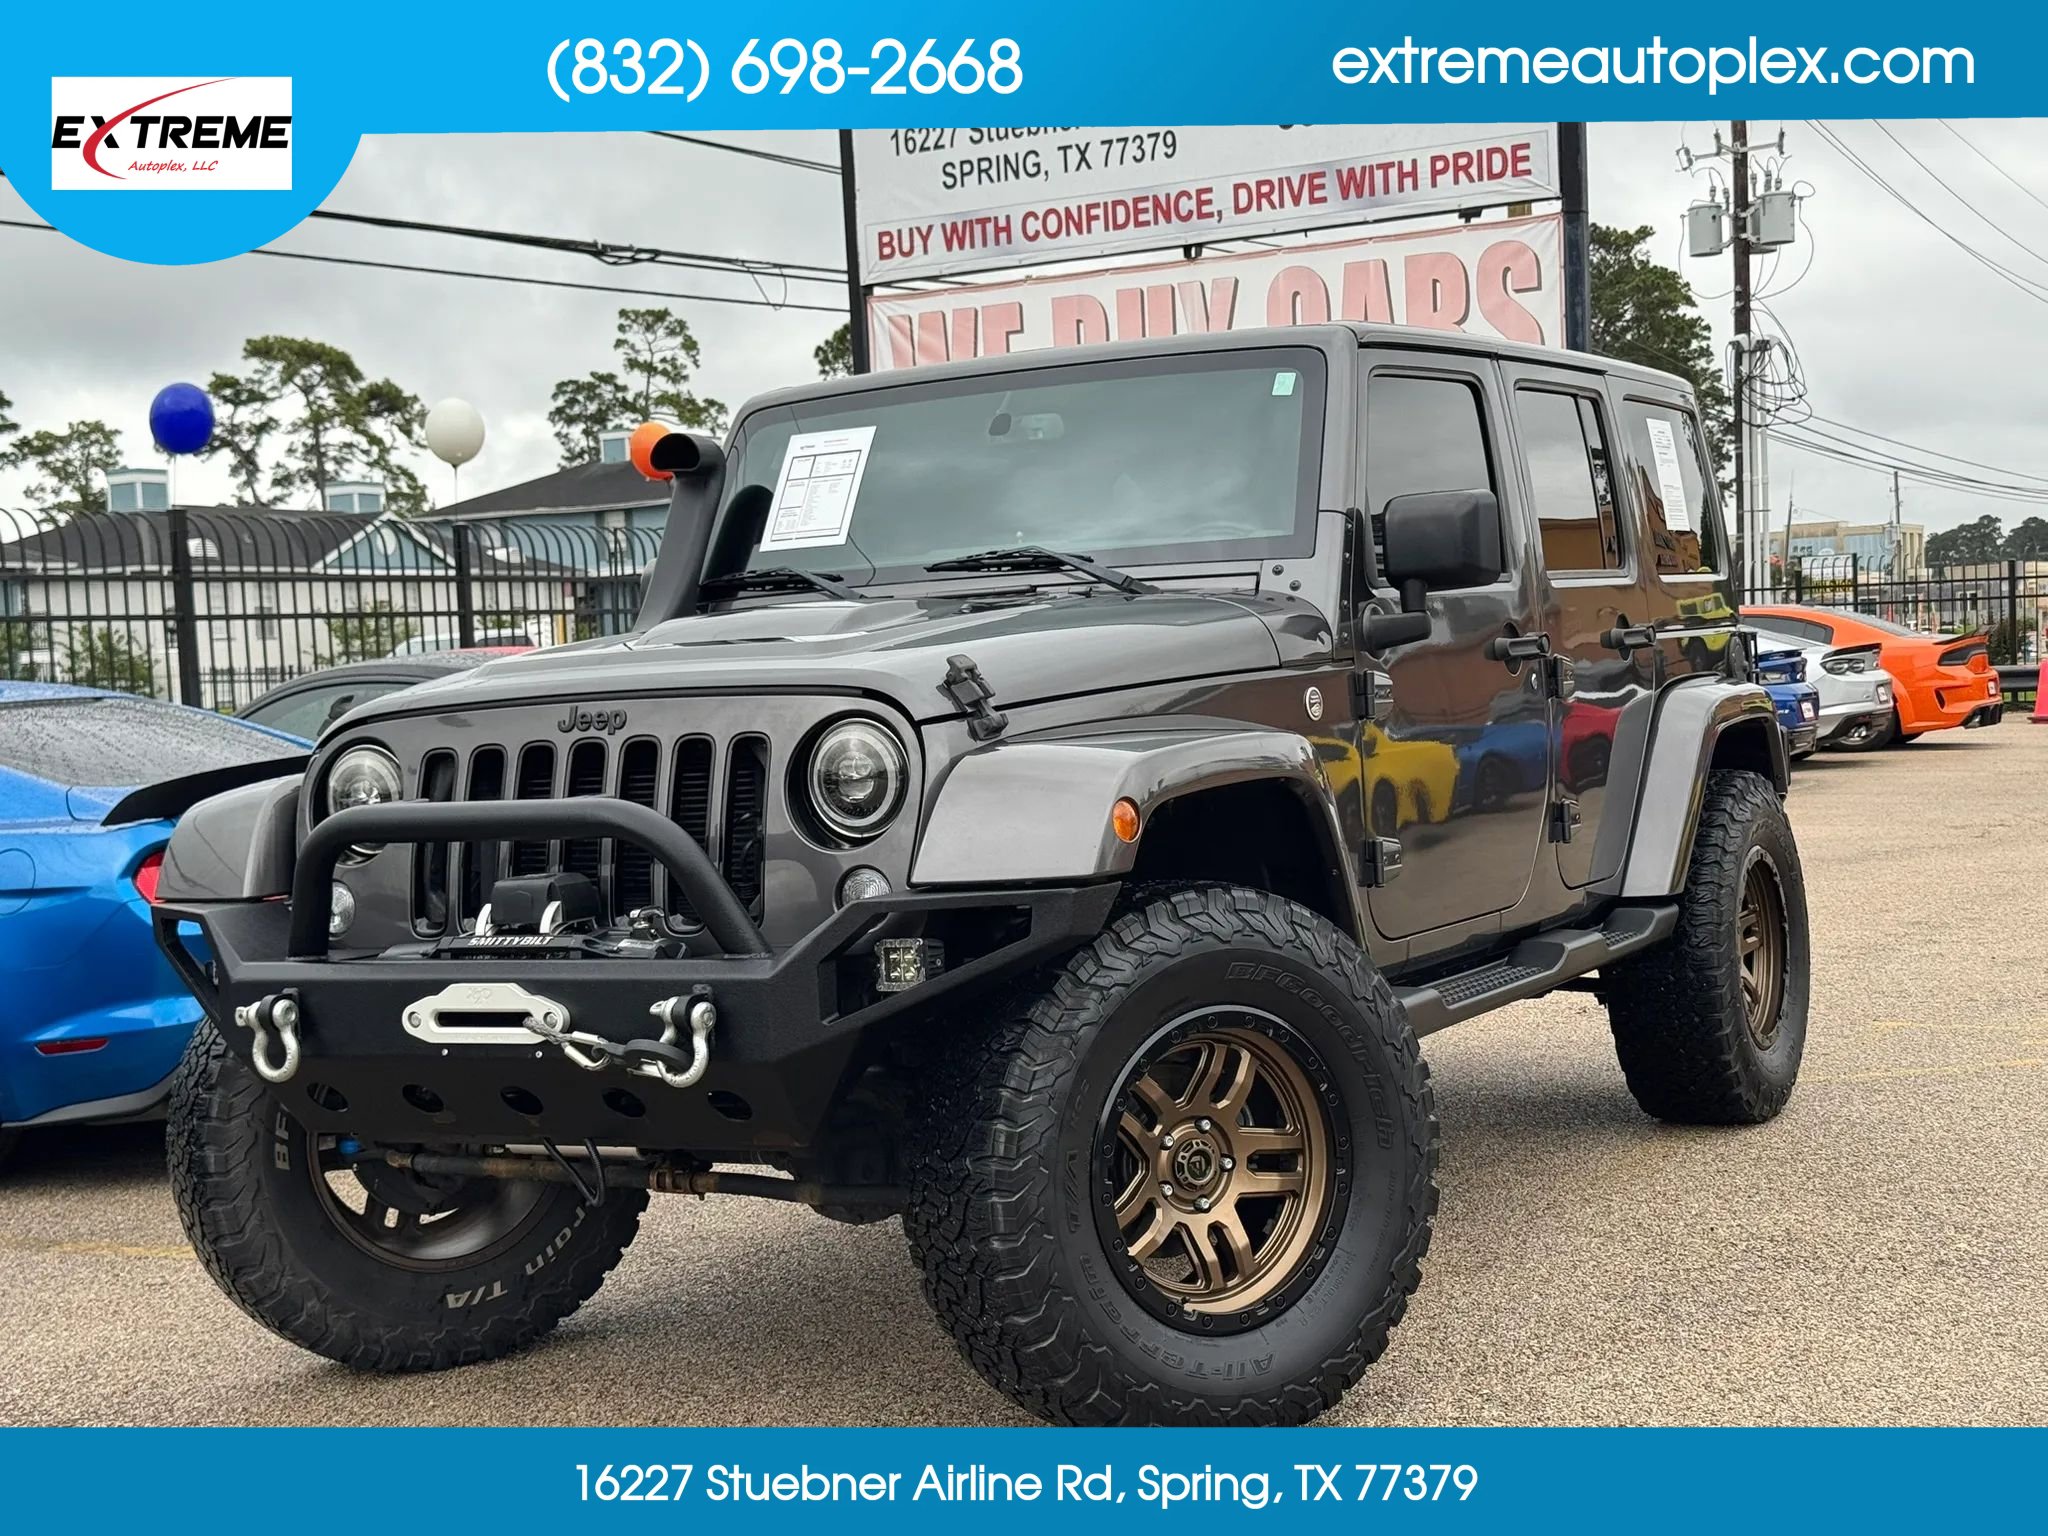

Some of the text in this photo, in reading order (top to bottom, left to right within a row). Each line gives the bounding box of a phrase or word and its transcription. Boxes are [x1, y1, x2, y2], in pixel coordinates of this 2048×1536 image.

[890, 128, 957, 156] 16227
[942, 131, 1177, 190] SPRING, TX 77379
[878, 142, 1532, 262] BUY WITH CONFIDENCE, DRIVE WITH PRIDE
[557, 705, 627, 735] Jeep
[468, 936, 554, 946] SMITTYBILT
[446, 1280, 509, 1309] T/A
